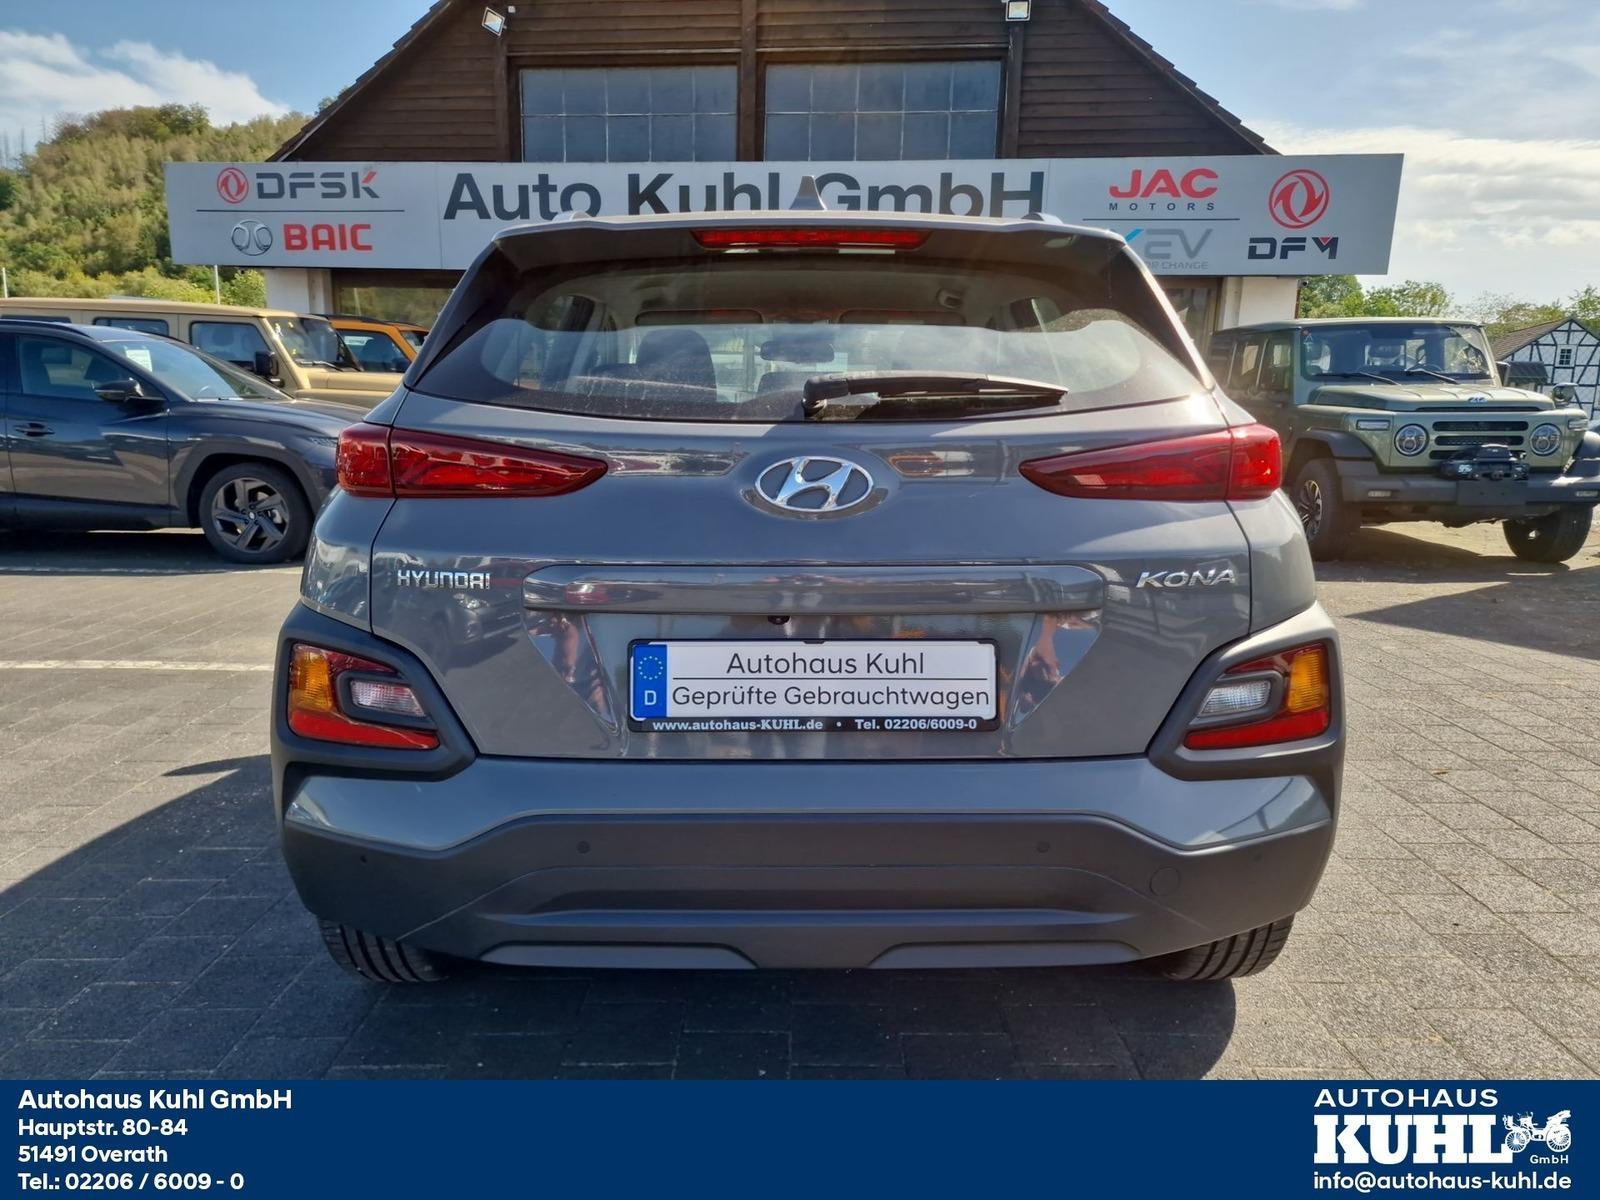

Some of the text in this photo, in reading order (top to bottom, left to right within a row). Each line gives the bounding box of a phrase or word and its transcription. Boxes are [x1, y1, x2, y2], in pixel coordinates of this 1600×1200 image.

[256, 171, 380, 199] DFSK
[1109, 168, 1219, 199] JAC
[443, 171, 1045, 220] Auto Kuhl GmbH
[1109, 202, 1216, 212] MOTORS
[283, 223, 373, 251] BAIC
[1161, 261, 1209, 270] CHANGE
[397, 569, 491, 590] HYUNDAI
[1136, 568, 1236, 588] KONA
[726, 652, 924, 674] Autohaus Kuhl
[644, 690, 657, 706] D
[672, 685, 989, 710] Geprüfte Gebrauchtwagen
[652, 718, 977, 731] www.autohaus-KUHL.de Tel. 02206/6009-0
